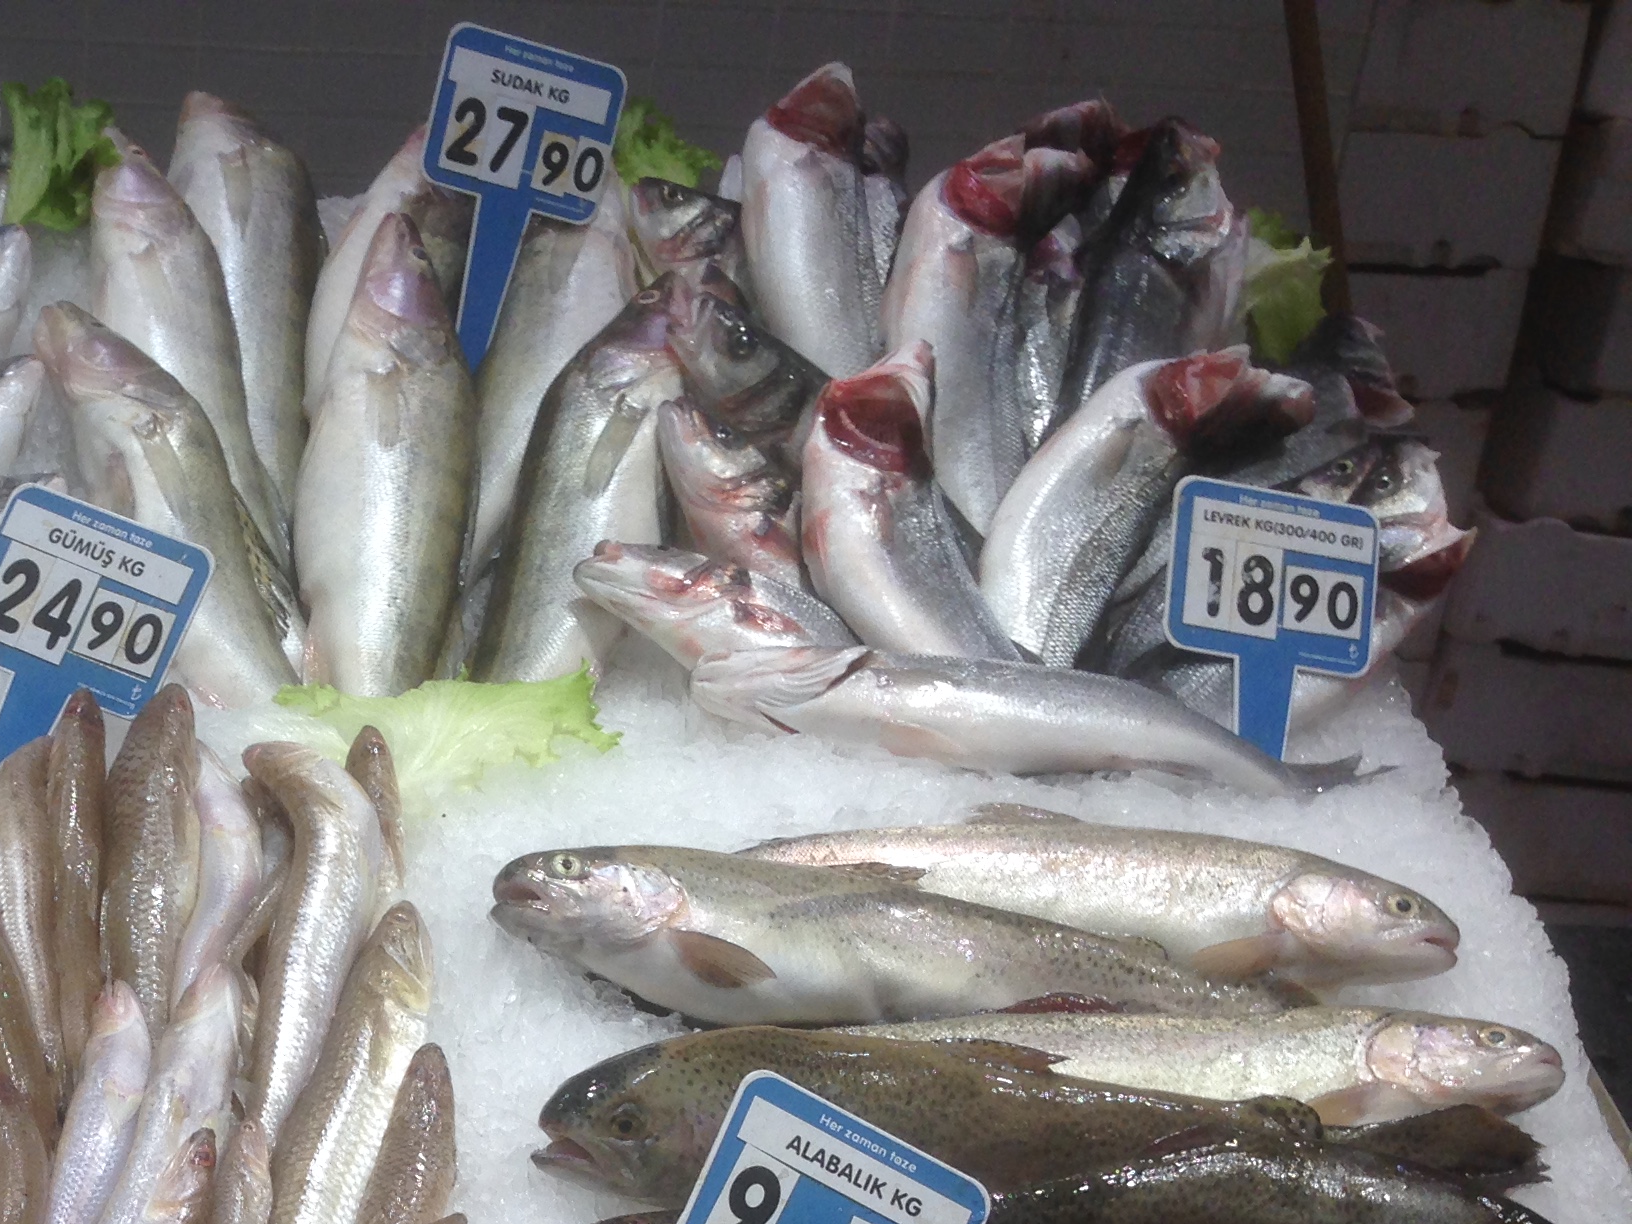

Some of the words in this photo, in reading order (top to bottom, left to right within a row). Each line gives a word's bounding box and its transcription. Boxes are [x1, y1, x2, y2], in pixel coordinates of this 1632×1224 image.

[491, 69, 544, 97] SUDAK
[549, 86, 570, 104] KG
[445, 97, 529, 173] 27
[542, 141, 604, 193] 90
[48, 527, 116, 569] GÜMÜŞ
[118, 556, 146, 577] KG
[71, 510, 92, 524] Her
[92, 520, 128, 539] zaman
[129, 532, 153, 548] taze
[1203, 509, 1251, 529] LEVREK
[1340, 534, 1364, 551] GR)
[1202, 548, 1274, 626] 18
[1290, 574, 1358, 631] 90
[87, 601, 163, 665] 90
[819, 1113, 843, 1133] Her
[843, 1128, 887, 1158] zaman
[889, 1149, 917, 1173] taze
[785, 1133, 889, 1200] ALABALIK
[890, 1188, 923, 1218] KG
